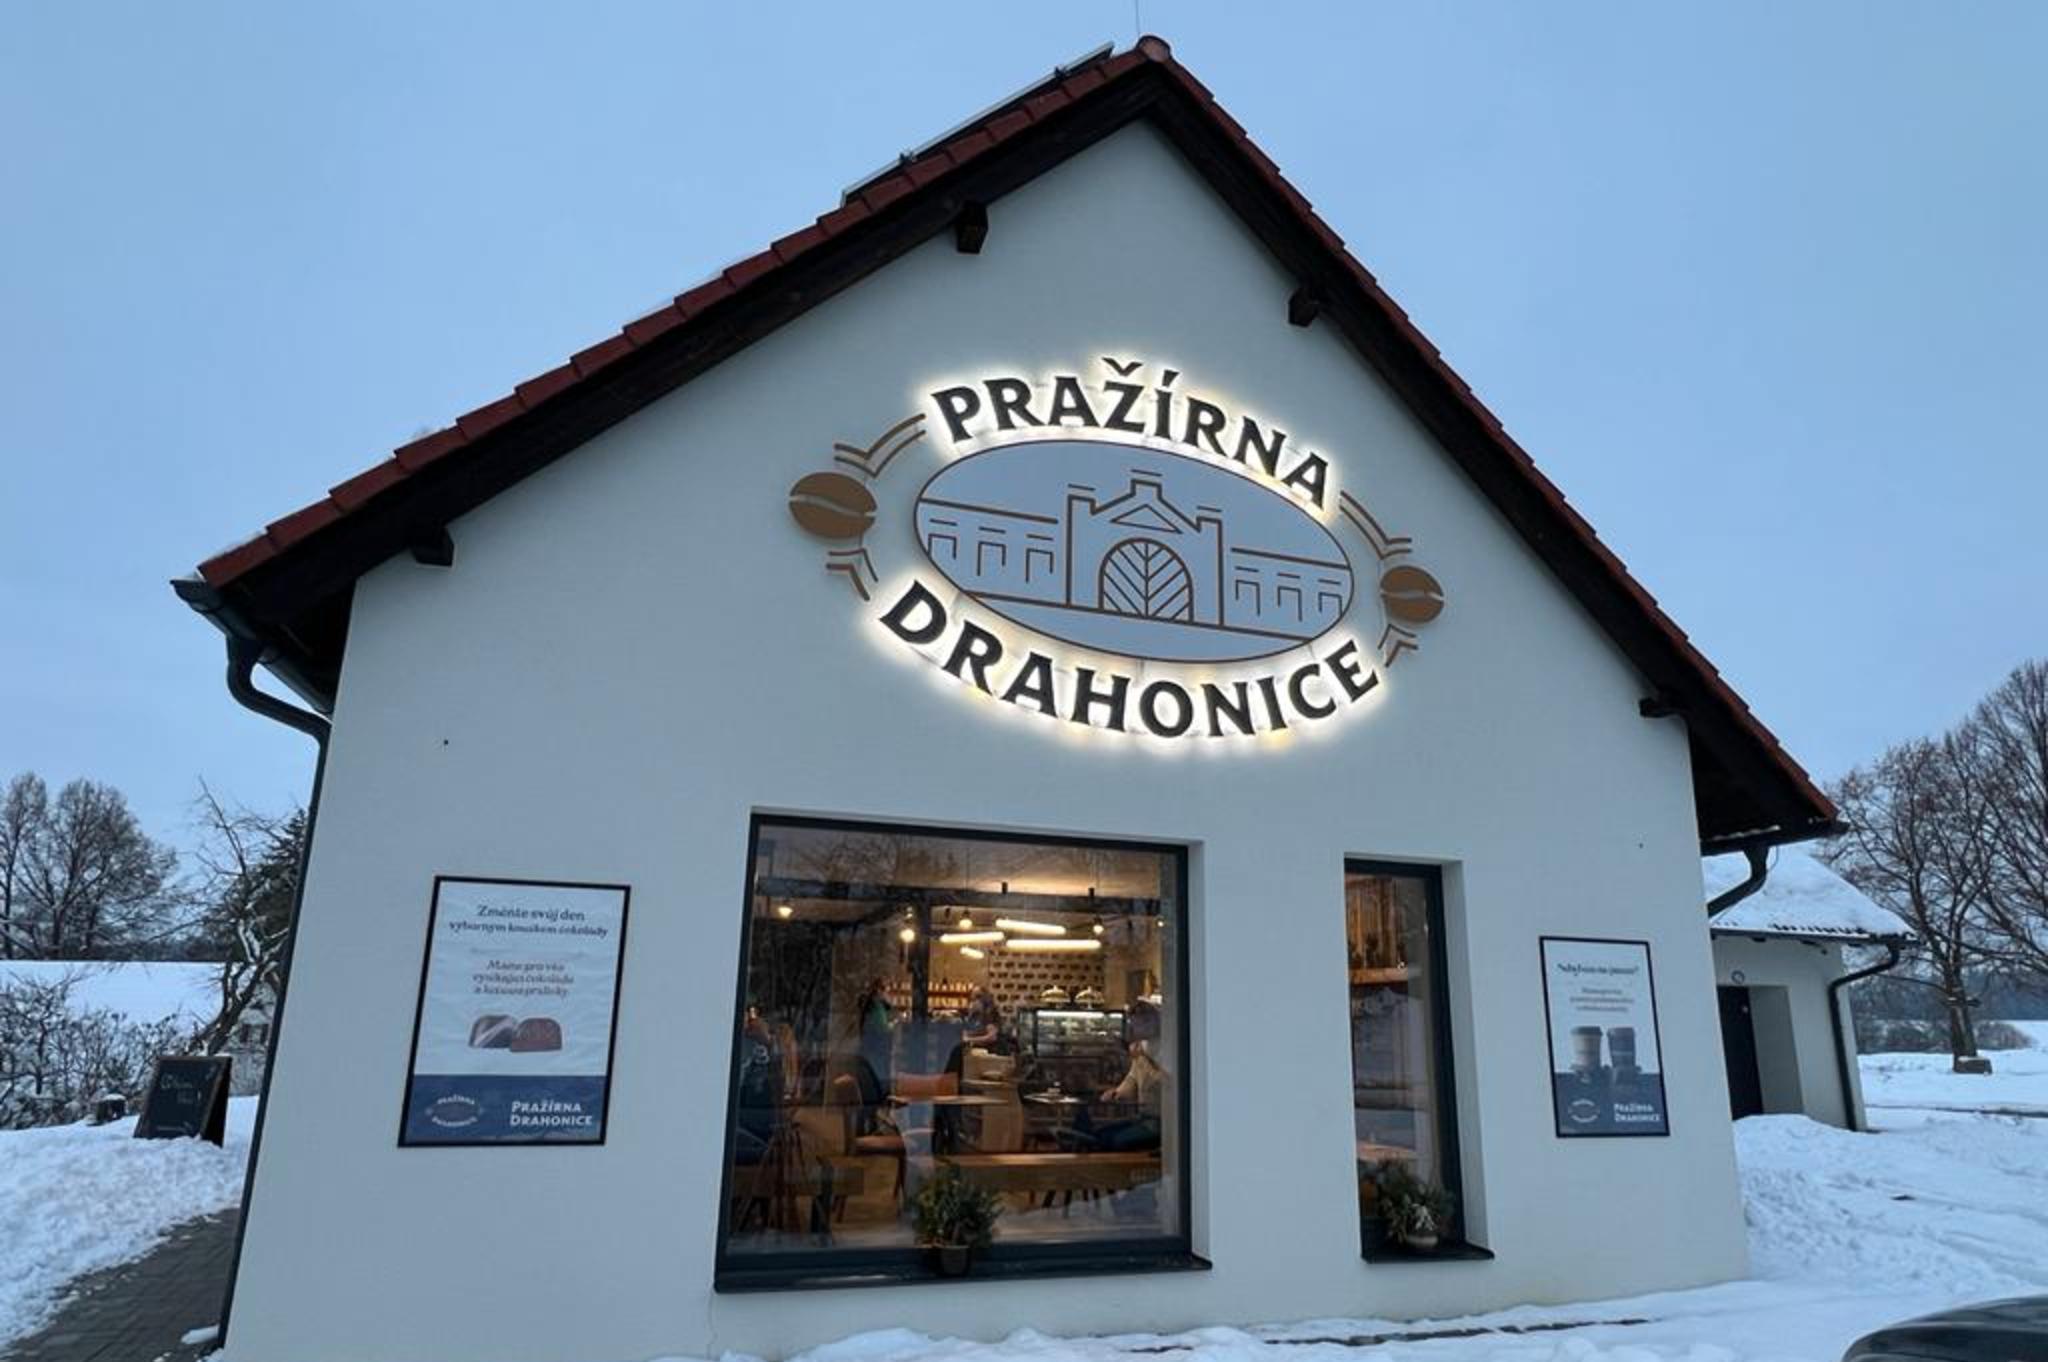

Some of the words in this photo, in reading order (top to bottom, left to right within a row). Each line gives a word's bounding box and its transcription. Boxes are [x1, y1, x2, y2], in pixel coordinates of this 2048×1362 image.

[931, 357, 1331, 510] PRAŽÍRNA
[878, 580, 1380, 739] DRAHONICE
[510, 1114, 593, 1126] DRAHONICE
